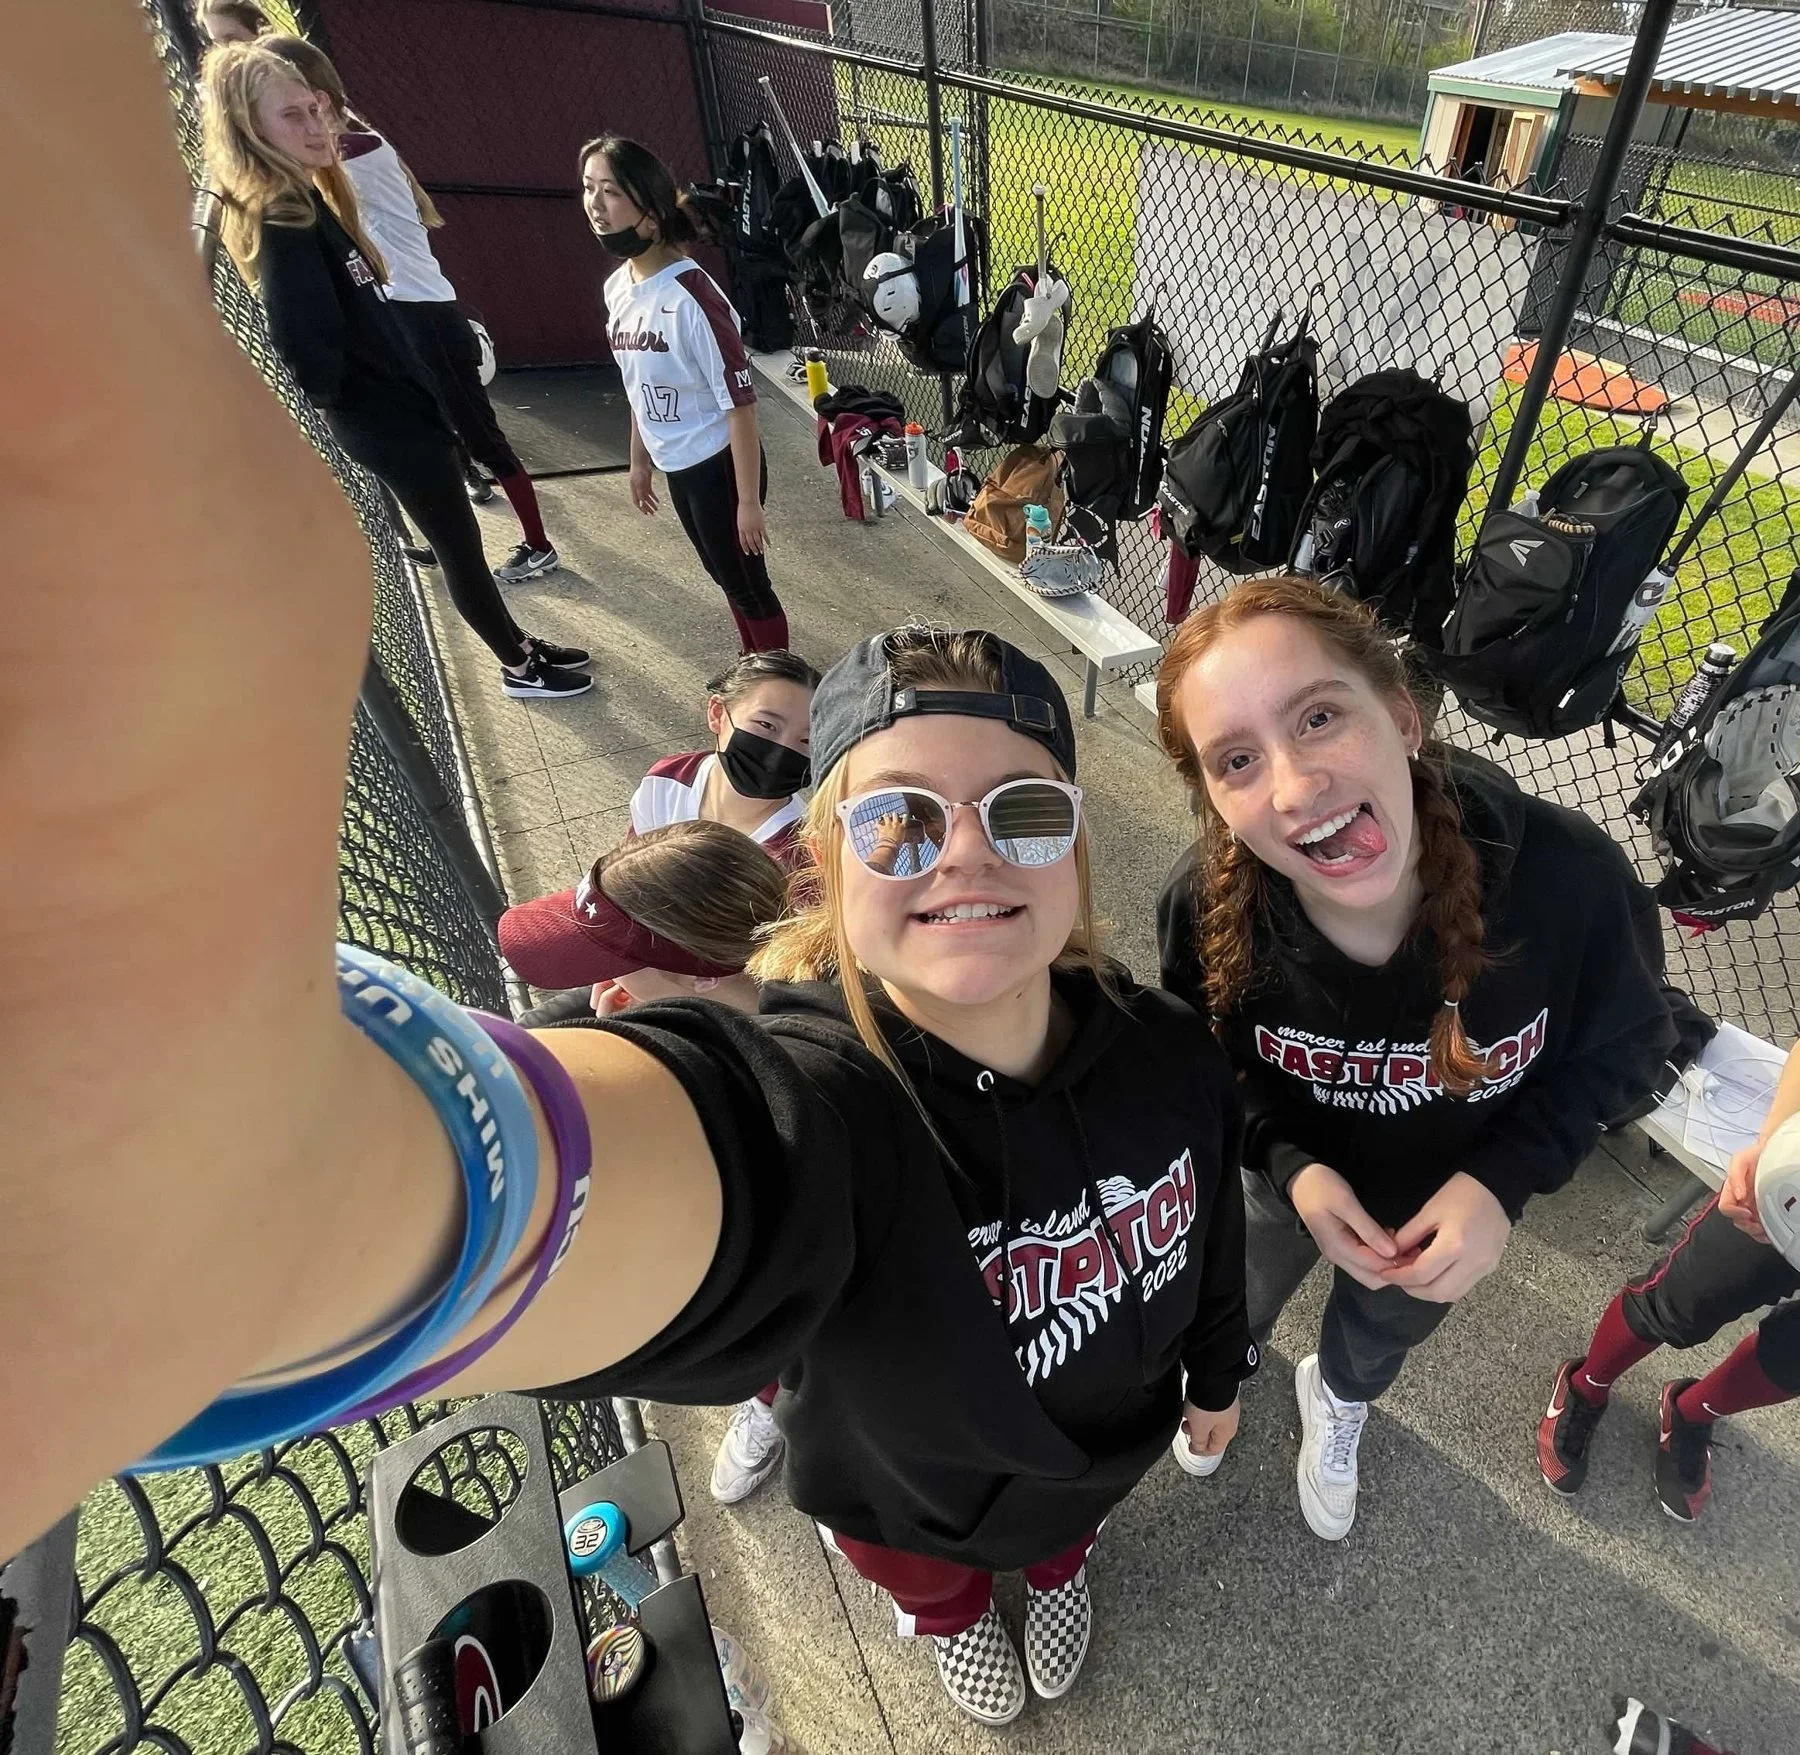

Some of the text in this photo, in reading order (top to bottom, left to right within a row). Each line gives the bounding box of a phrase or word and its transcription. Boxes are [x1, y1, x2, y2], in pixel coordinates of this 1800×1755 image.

[609, 315, 670, 353] landers
[641, 382, 681, 422] 17
[1020, 386, 1032, 428] EAS
[1690, 898, 1755, 916] EASTON
[1255, 1007, 1549, 1090] FASTPICH
[1277, 1025, 1345, 1050] mercer
[1466, 1071, 1525, 1103] 2022
[1020, 1187, 1091, 1238] island
[975, 1147, 1197, 1325] STPITCH
[1142, 1239, 1188, 1303] 2022
[574, 1532, 600, 1551] 32
